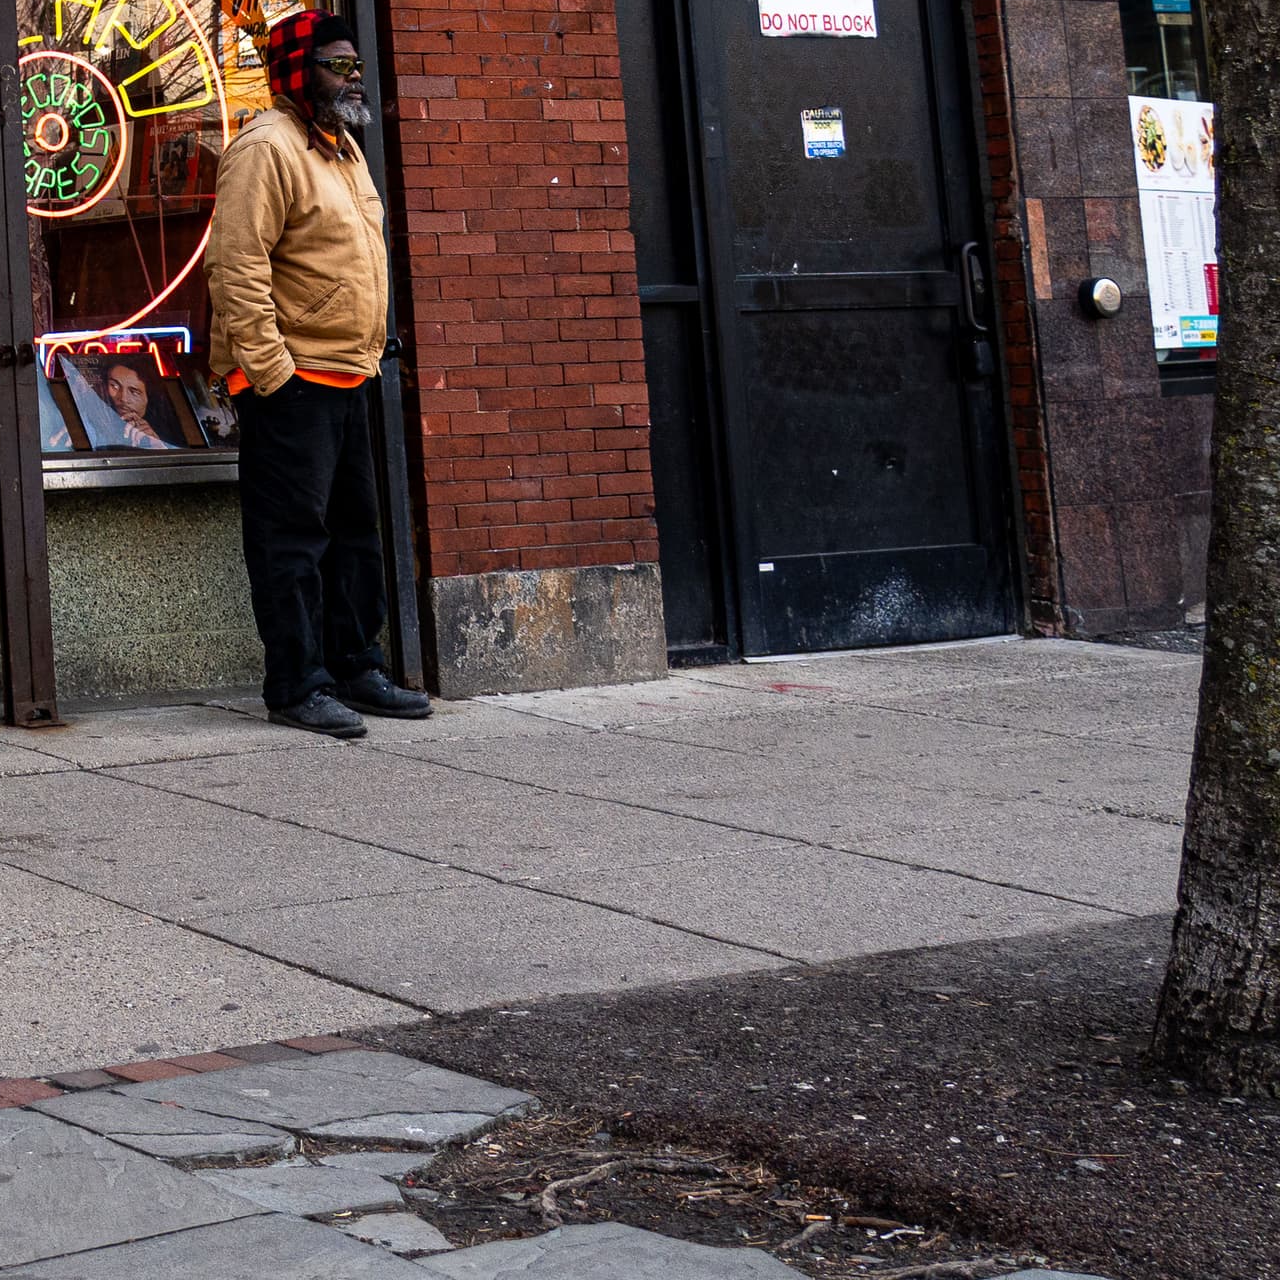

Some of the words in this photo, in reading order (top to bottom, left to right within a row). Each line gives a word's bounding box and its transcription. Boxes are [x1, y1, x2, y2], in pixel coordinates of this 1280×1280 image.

[761, 13, 783, 31] DO
[787, 13, 818, 31] NOT
[822, 14, 874, 32] BLOCK
